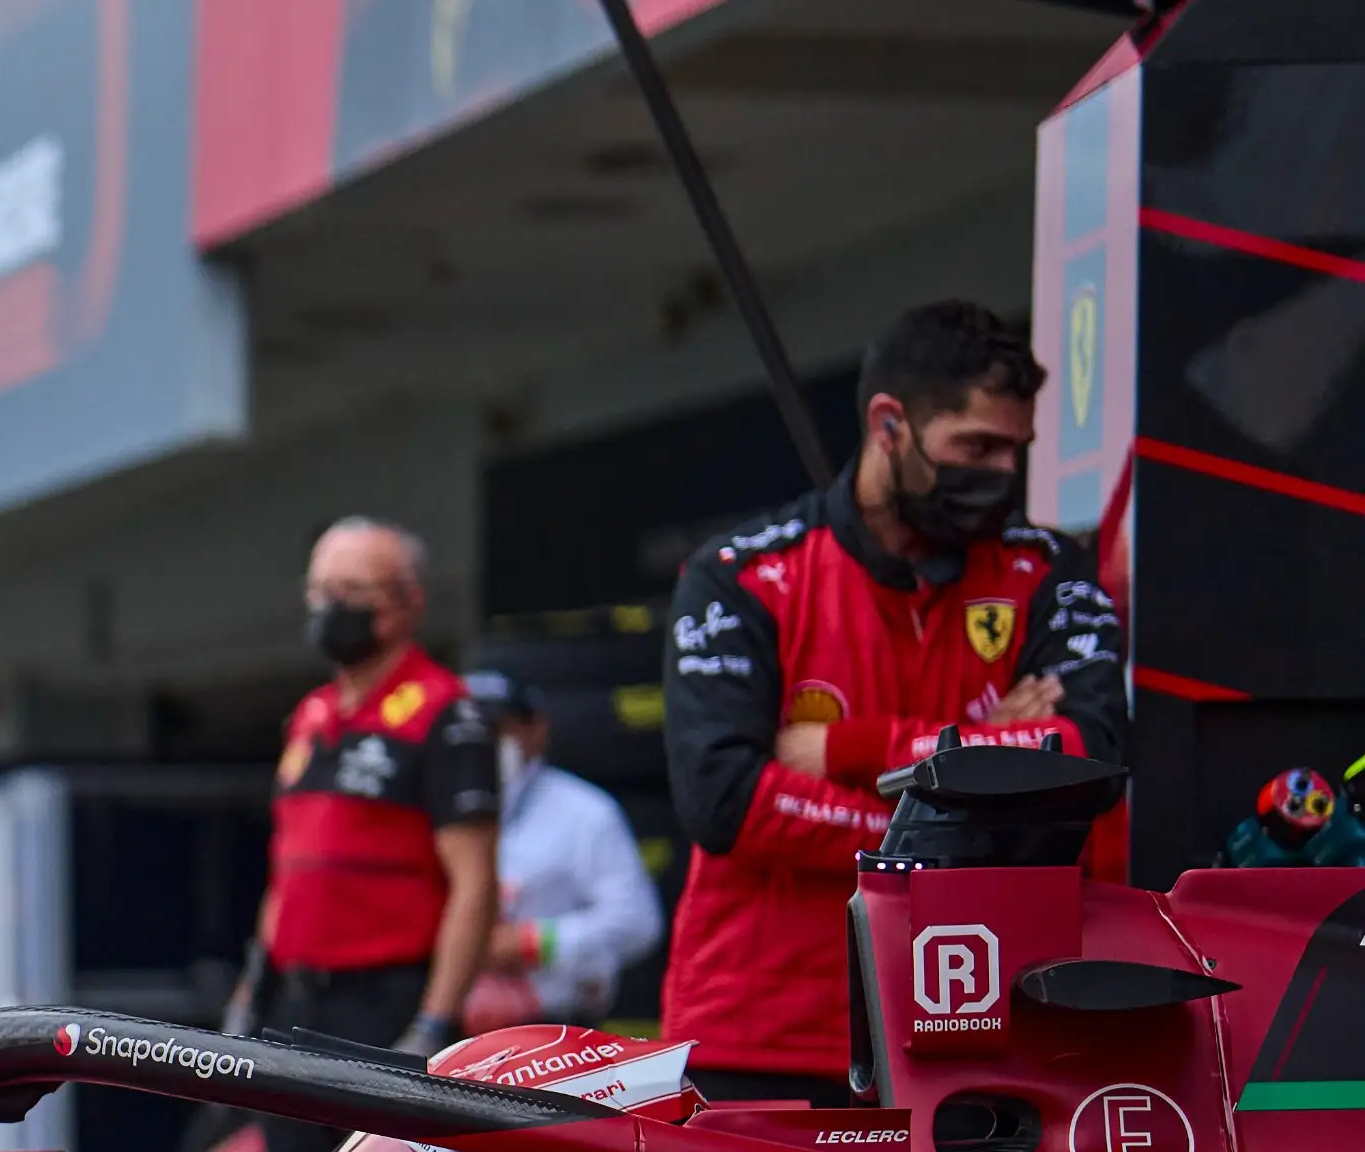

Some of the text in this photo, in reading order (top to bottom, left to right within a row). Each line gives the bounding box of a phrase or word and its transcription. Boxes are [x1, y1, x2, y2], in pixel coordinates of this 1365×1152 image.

[914, 1016, 1002, 1032] RADIOBOOK
[85, 1026, 255, 1081] Snapdragon
[815, 1129, 910, 1145] LECLERC
